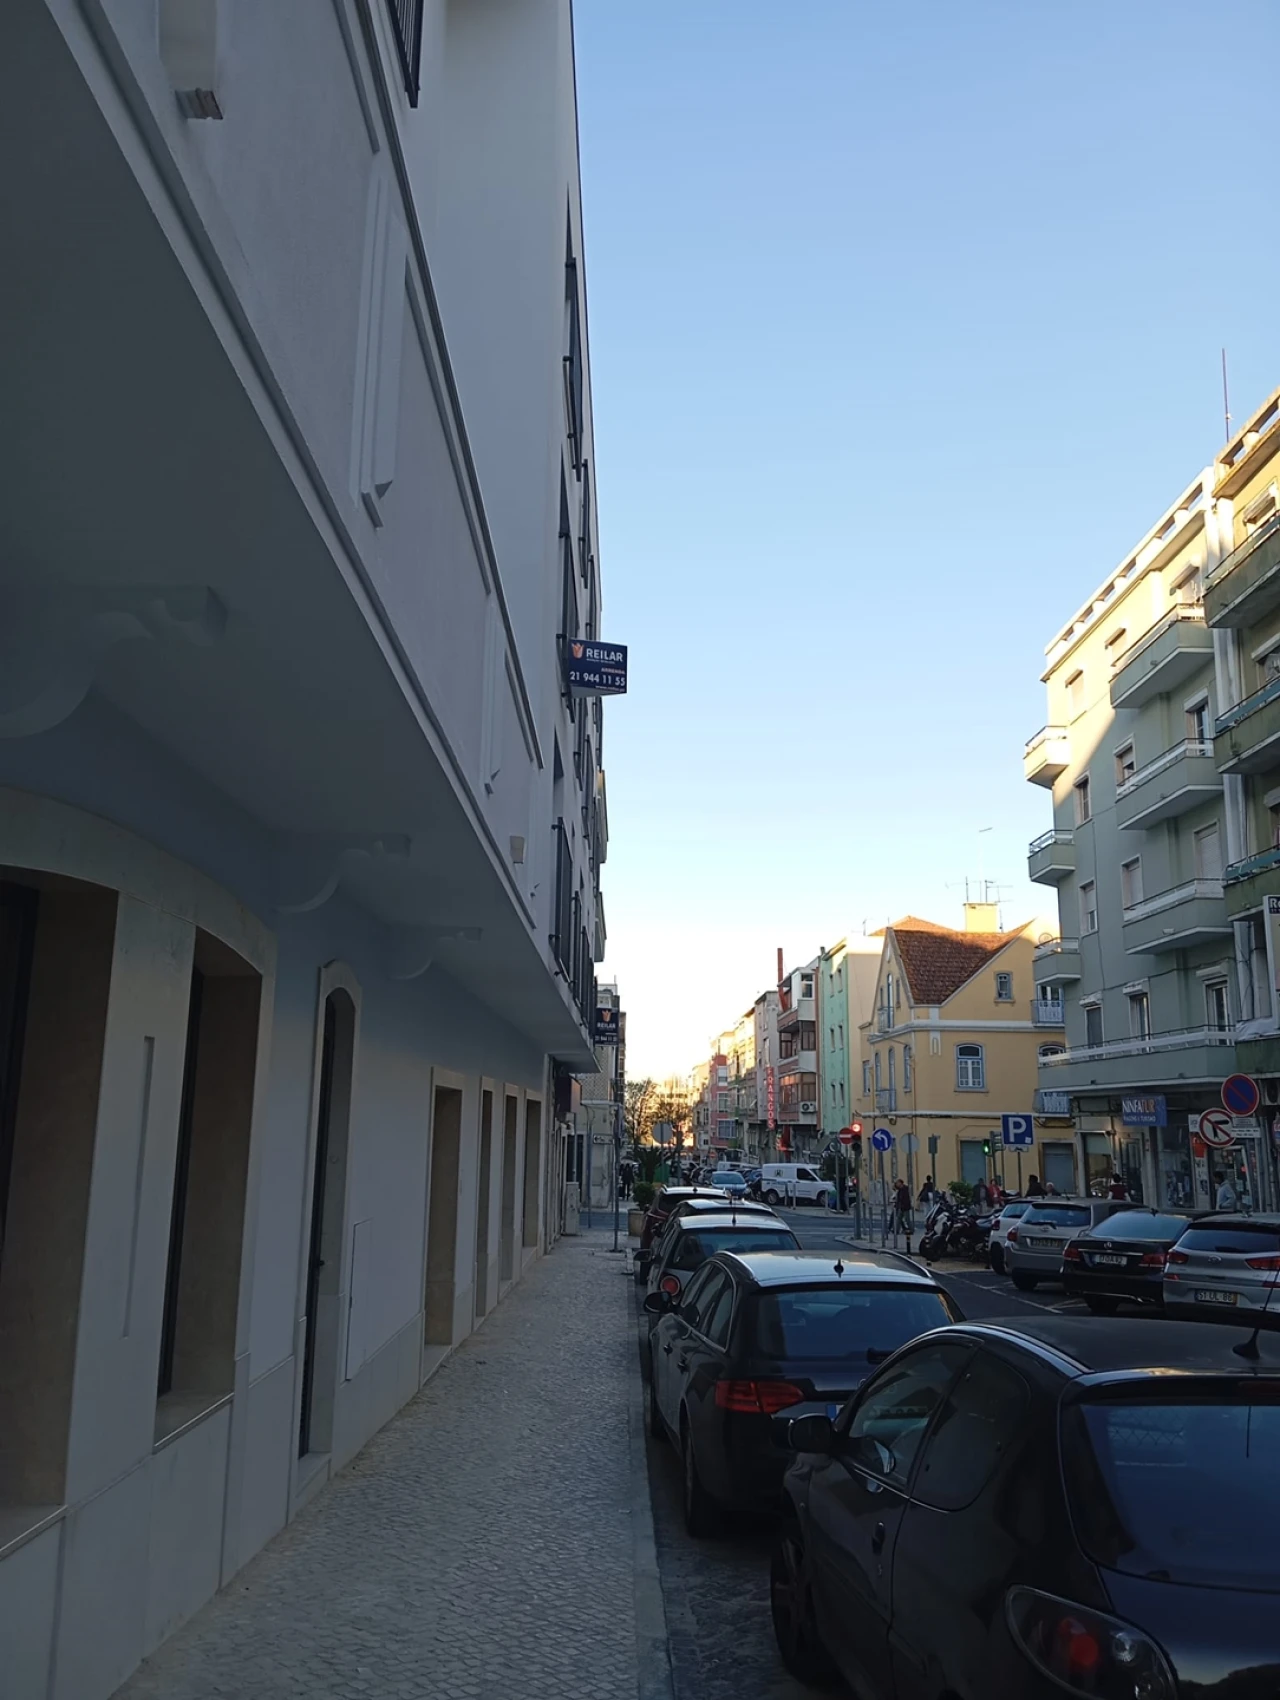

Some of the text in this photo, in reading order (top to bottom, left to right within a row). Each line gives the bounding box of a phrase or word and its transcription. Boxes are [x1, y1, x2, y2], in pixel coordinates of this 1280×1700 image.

[586, 648, 623, 662] REILAR
[569, 671, 625, 687] 21 944 11 55
[1008, 1117, 1027, 1142] P
